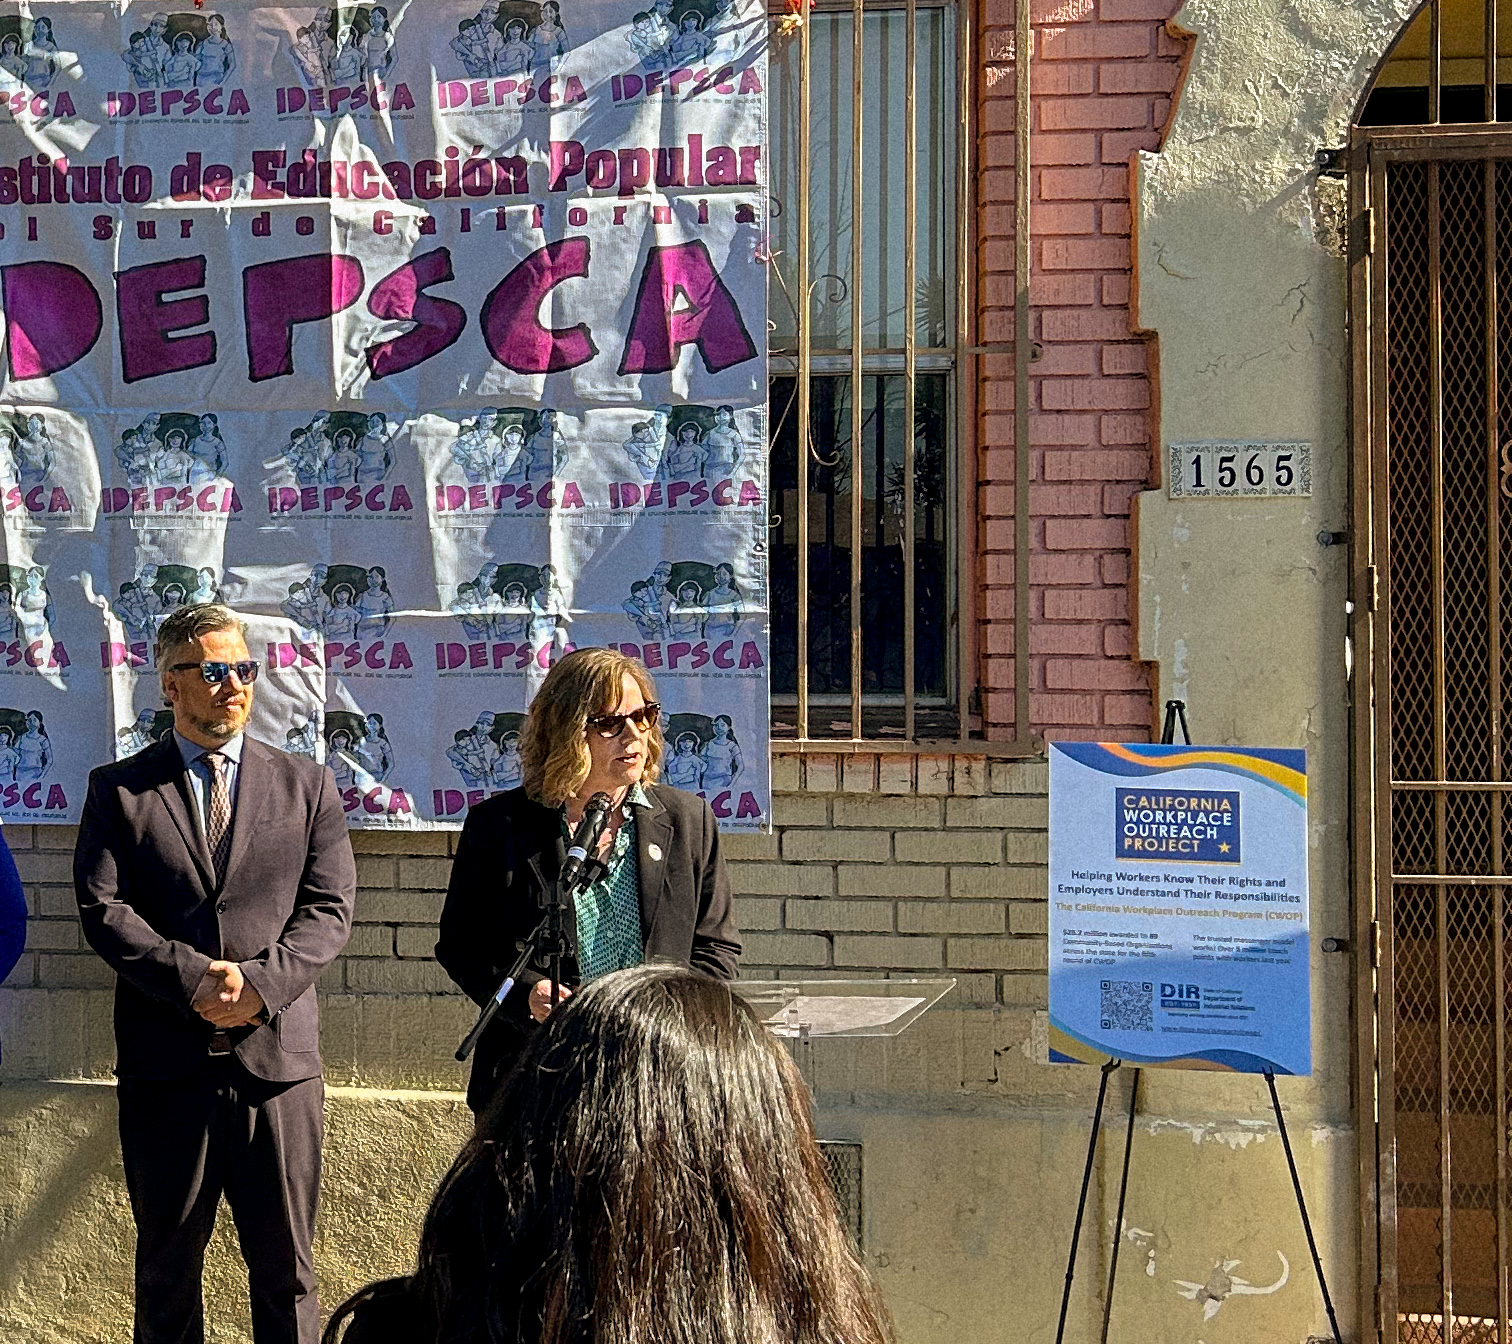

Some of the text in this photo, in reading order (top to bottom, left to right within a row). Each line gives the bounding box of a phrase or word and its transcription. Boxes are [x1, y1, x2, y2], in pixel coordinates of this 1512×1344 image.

[276, 82, 415, 115] IDEPSCA
[437, 74, 588, 110] IDEPSCA
[611, 67, 763, 102] IDEPSCA
[106, 88, 250, 118] IDEPSCA
[170, 152, 233, 202] de
[251, 145, 529, 201] Educación
[547, 134, 760, 197] Popular
[93, 215, 194, 240] Sur
[252, 212, 314, 237] de
[372, 200, 756, 235] California
[1191, 453, 1294, 487] 1565
[102, 485, 243, 514] IDEPSCA
[268, 484, 413, 514] IDEPSCA
[435, 481, 585, 513] IDEPSCA
[608, 478, 761, 511] IDEPSCA
[266, 641, 413, 671] IDEPSCA
[1124, 795, 1232, 811] CALIFORNIA
[1124, 809, 1232, 825] WORKPLACE
[1124, 823, 1217, 839] OUTREACH
[1124, 838, 1200, 852] PROJECT
[1058, 884, 1300, 903] Employers Understand Their Responsibilities
[1071, 870, 1286, 887] Helping Workers Know Their Rights and
[1055, 902, 1073, 911] The
[1075, 903, 1120, 913] California
[1122, 905, 1173, 916] Workplace
[1176, 907, 1219, 918] Outreach
[1223, 910, 1263, 920] Program
[1160, 982, 1200, 999] DIR
